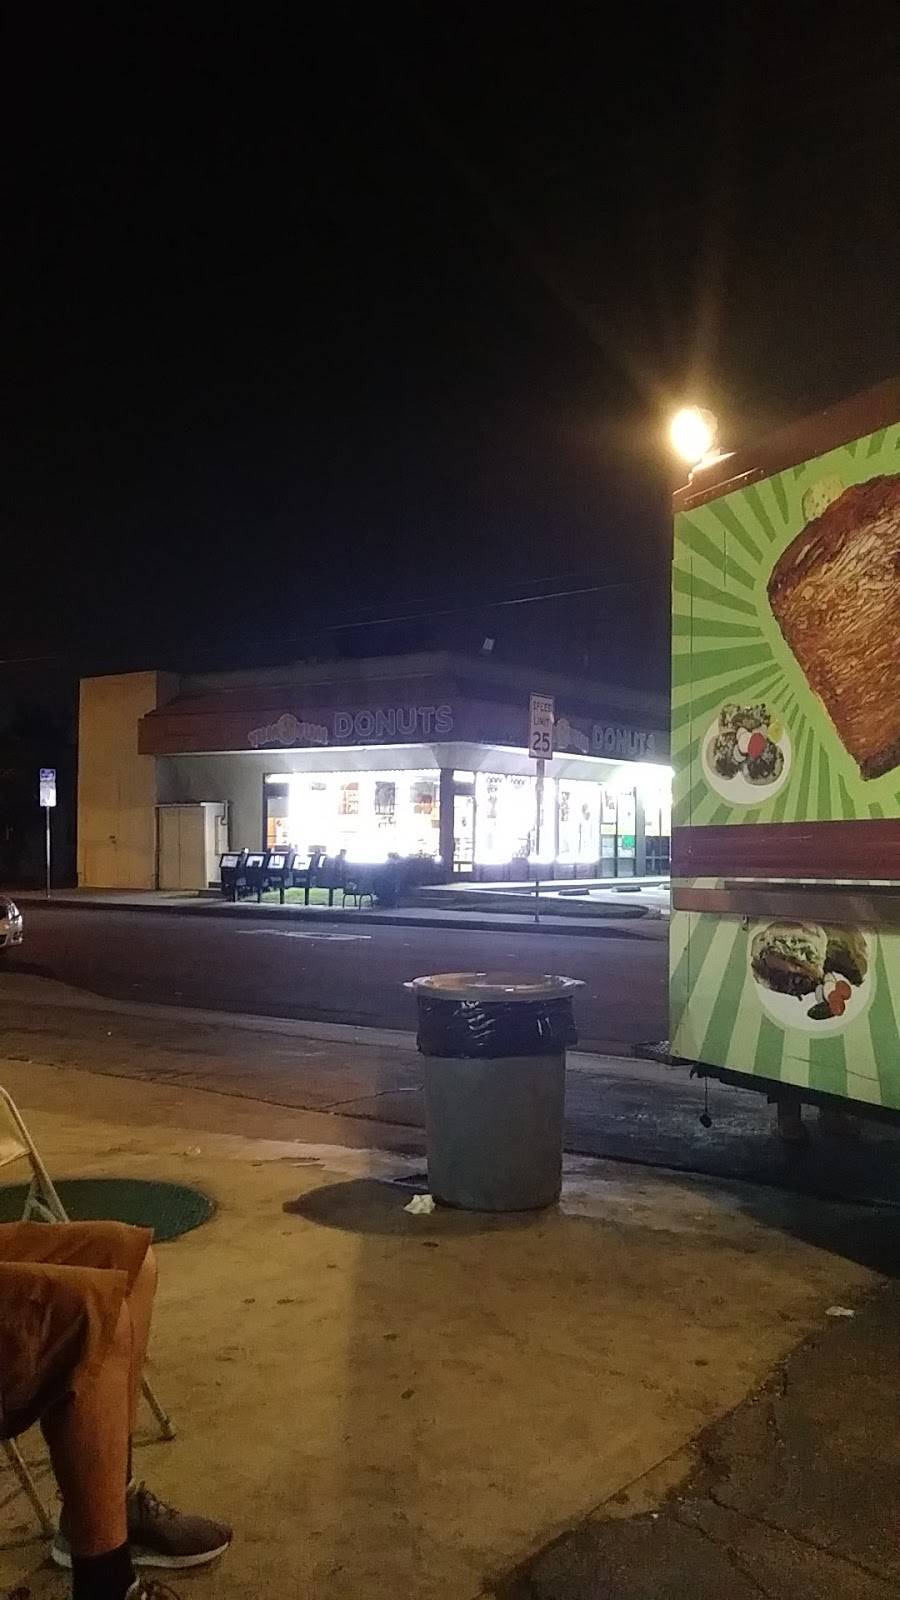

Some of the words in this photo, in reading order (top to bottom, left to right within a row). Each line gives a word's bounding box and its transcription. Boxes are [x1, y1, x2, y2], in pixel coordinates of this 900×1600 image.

[532, 701, 552, 712] SPEED
[334, 705, 454, 738] DONUTS
[533, 714, 551, 726] LIMIT
[532, 731, 550, 752] 25
[592, 724, 656, 756] DONUTS
